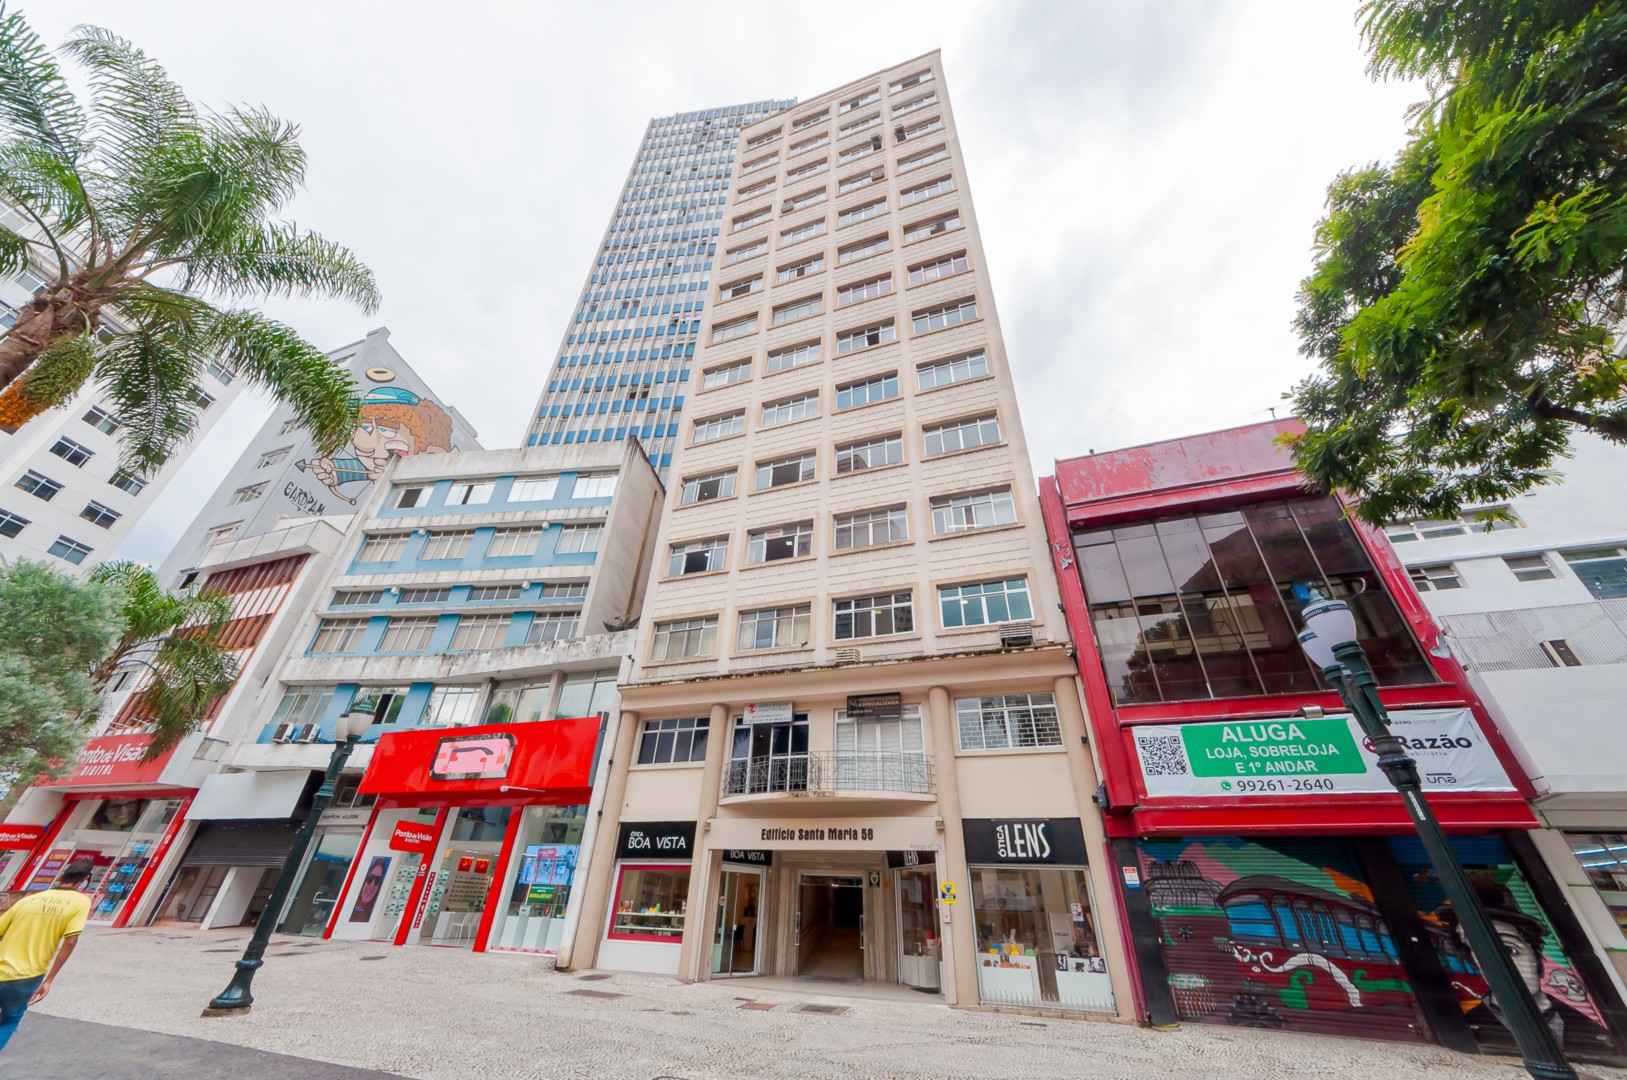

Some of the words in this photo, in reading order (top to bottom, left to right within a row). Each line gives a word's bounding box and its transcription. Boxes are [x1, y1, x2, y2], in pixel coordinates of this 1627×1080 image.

[1222, 723, 1306, 743] ALUGA
[1394, 734, 1473, 750] Razão
[79, 745, 105, 764] onto
[1205, 747, 1247, 760] LOJA,
[1249, 743, 1340, 757] SOBRELOJA
[1234, 762, 1246, 773] E
[1265, 760, 1319, 773] ANDAR
[1236, 778, 1334, 792] 99261-2640
[394, 828, 414, 839] Ponto
[416, 832, 433, 842] Visão
[760, 828, 796, 841] Edifício
[798, 828, 825, 841] Santa
[827, 828, 859, 841] Maria
[861, 828, 874, 841] 58
[995, 825, 1007, 858] ÓTICA
[1003, 822, 1051, 858] LENS
[628, 837, 651, 849] BOA
[655, 836, 687, 849] VISTA
[729, 850, 745, 860] BOA
[747, 851, 766, 862] VISTA
